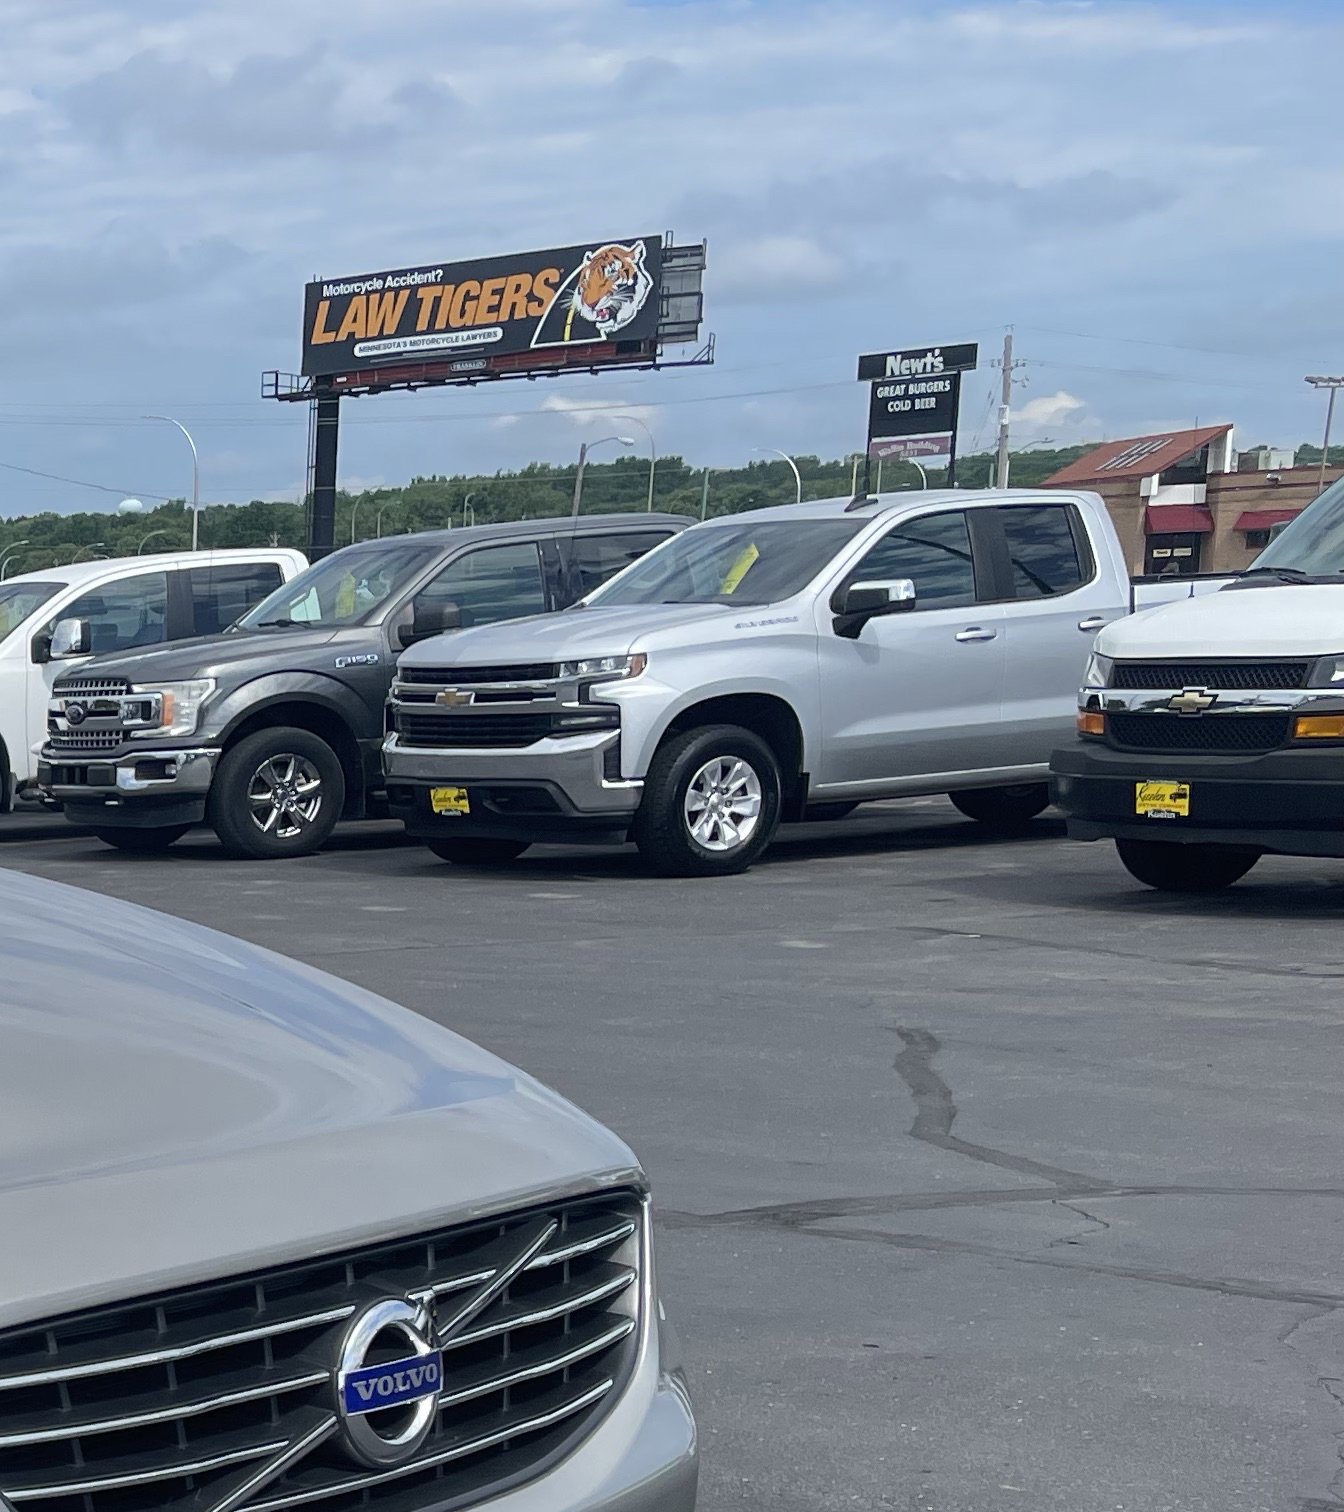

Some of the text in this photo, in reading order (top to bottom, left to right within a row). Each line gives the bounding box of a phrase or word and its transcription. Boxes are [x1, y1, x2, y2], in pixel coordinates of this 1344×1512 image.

[322, 269, 444, 298] Motorcycle Accident?
[310, 267, 561, 345] LAW TIGERS
[885, 348, 944, 377] Newt's
[876, 380, 951, 399] GREAT BURGERS
[887, 397, 936, 413] COLD BEER
[352, 1362, 438, 1401] VOLVO
